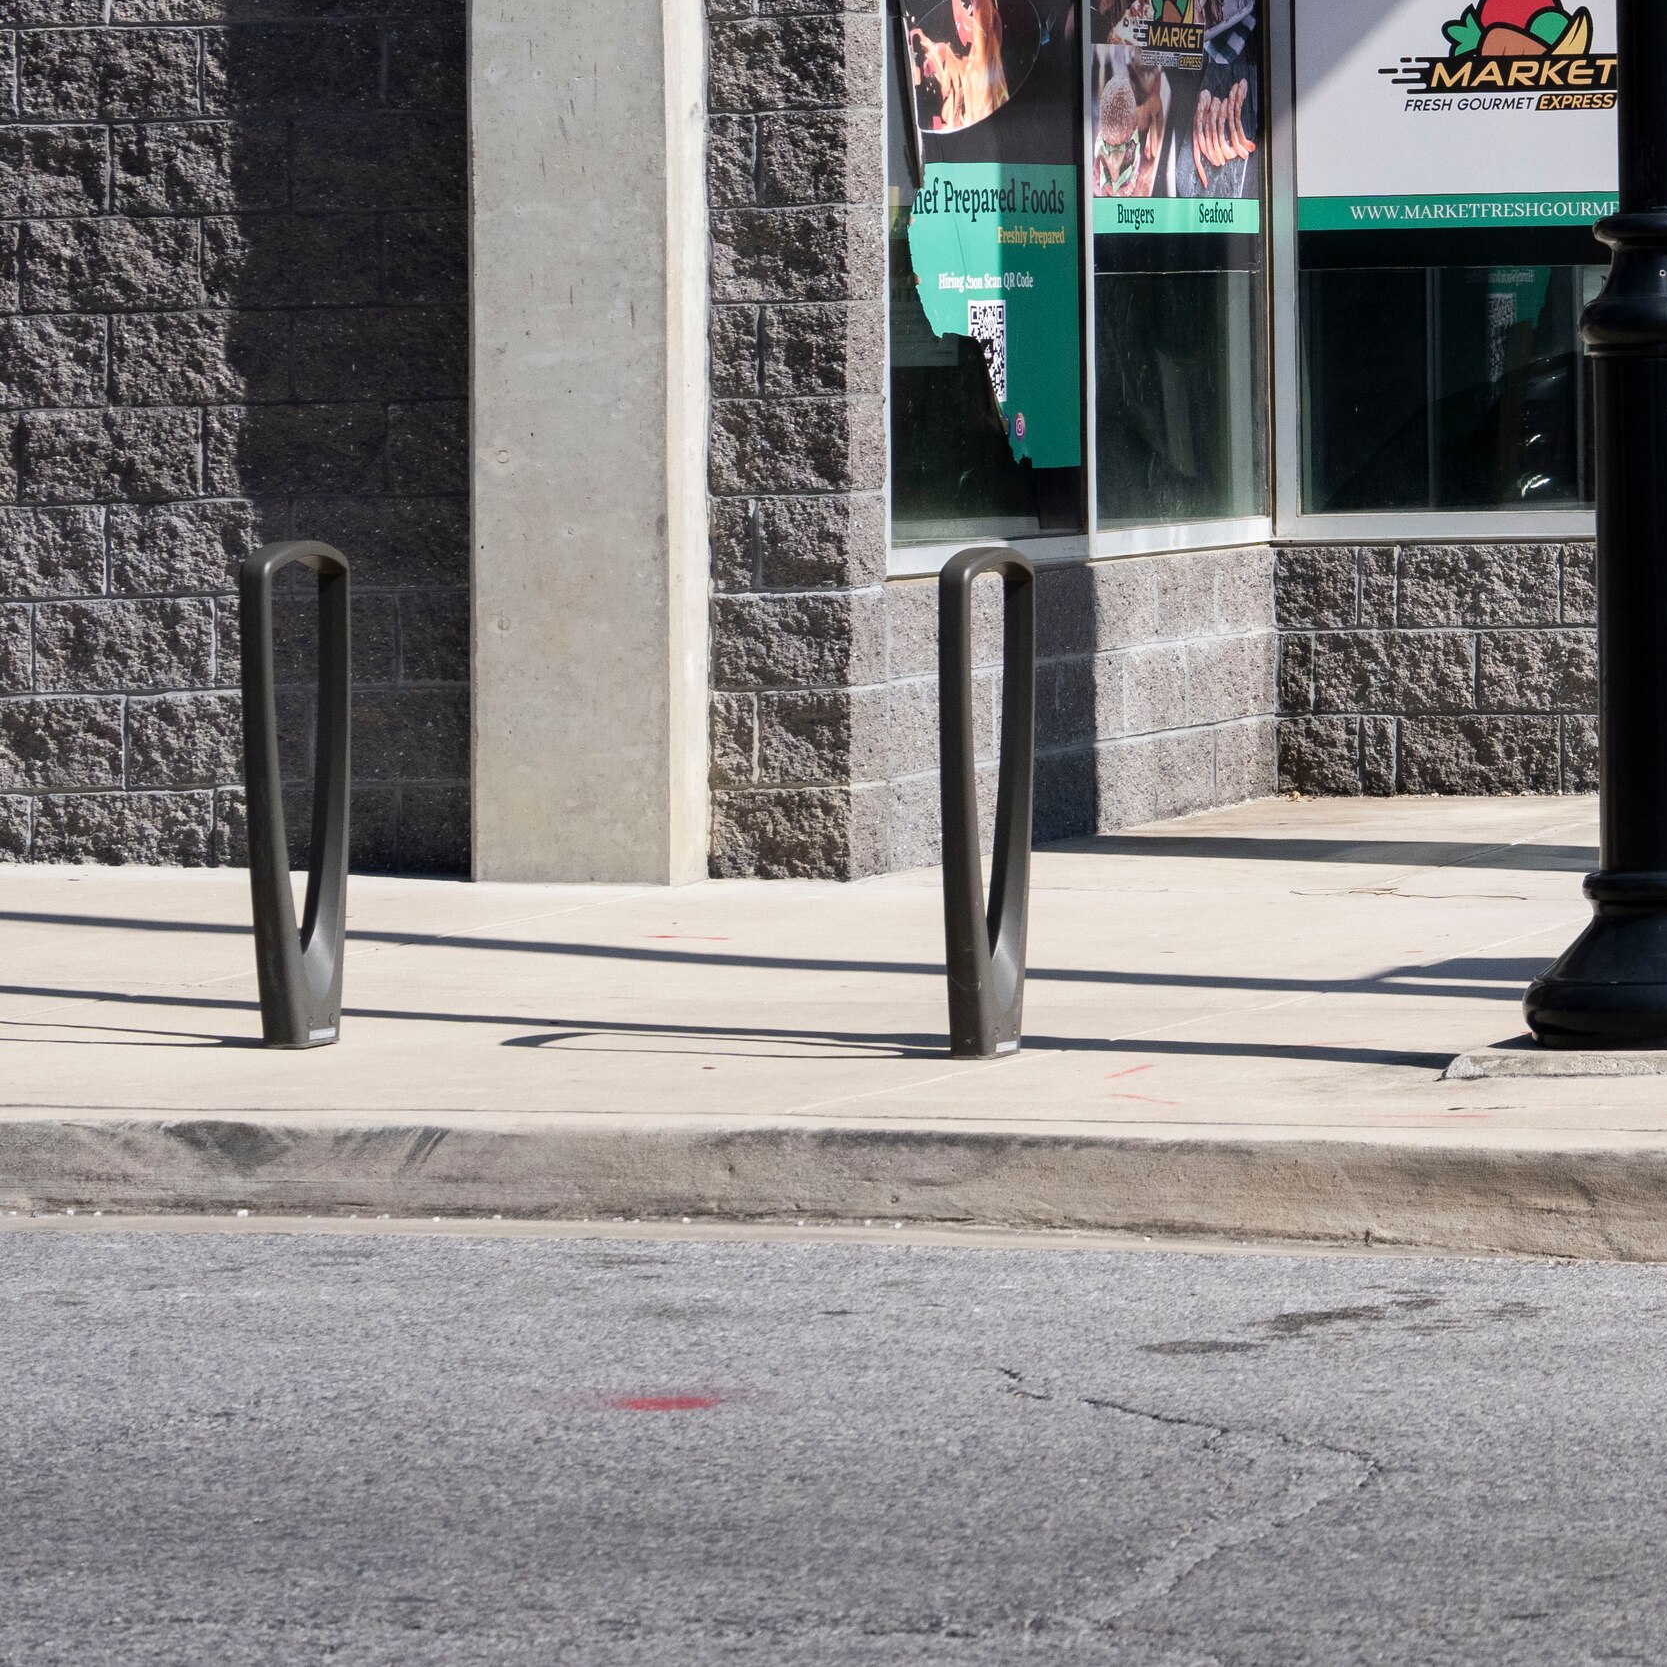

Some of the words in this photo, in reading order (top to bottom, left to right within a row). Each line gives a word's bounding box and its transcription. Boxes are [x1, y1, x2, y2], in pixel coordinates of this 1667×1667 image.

[1148, 25, 1204, 49] MARKET
[1179, 55, 1202, 69] EXPRESS
[1430, 59, 1617, 87] MARKET
[1404, 98, 1452, 112] FRESH
[1457, 97, 1534, 111] GOURMET
[1538, 93, 1615, 110] EXPRESS
[943, 178, 1016, 222] Prepared
[1021, 179, 1065, 215] Foods
[1117, 203, 1155, 230] Burgers
[1199, 201, 1234, 224] Seafood
[997, 225, 1027, 248] Freshly
[1029, 225, 1065, 249] Prepared
[938, 272, 964, 293] Hiring
[984, 273, 1002, 288] Scan
[1003, 272, 1016, 291] QR
[1016, 271, 1034, 288] Code
